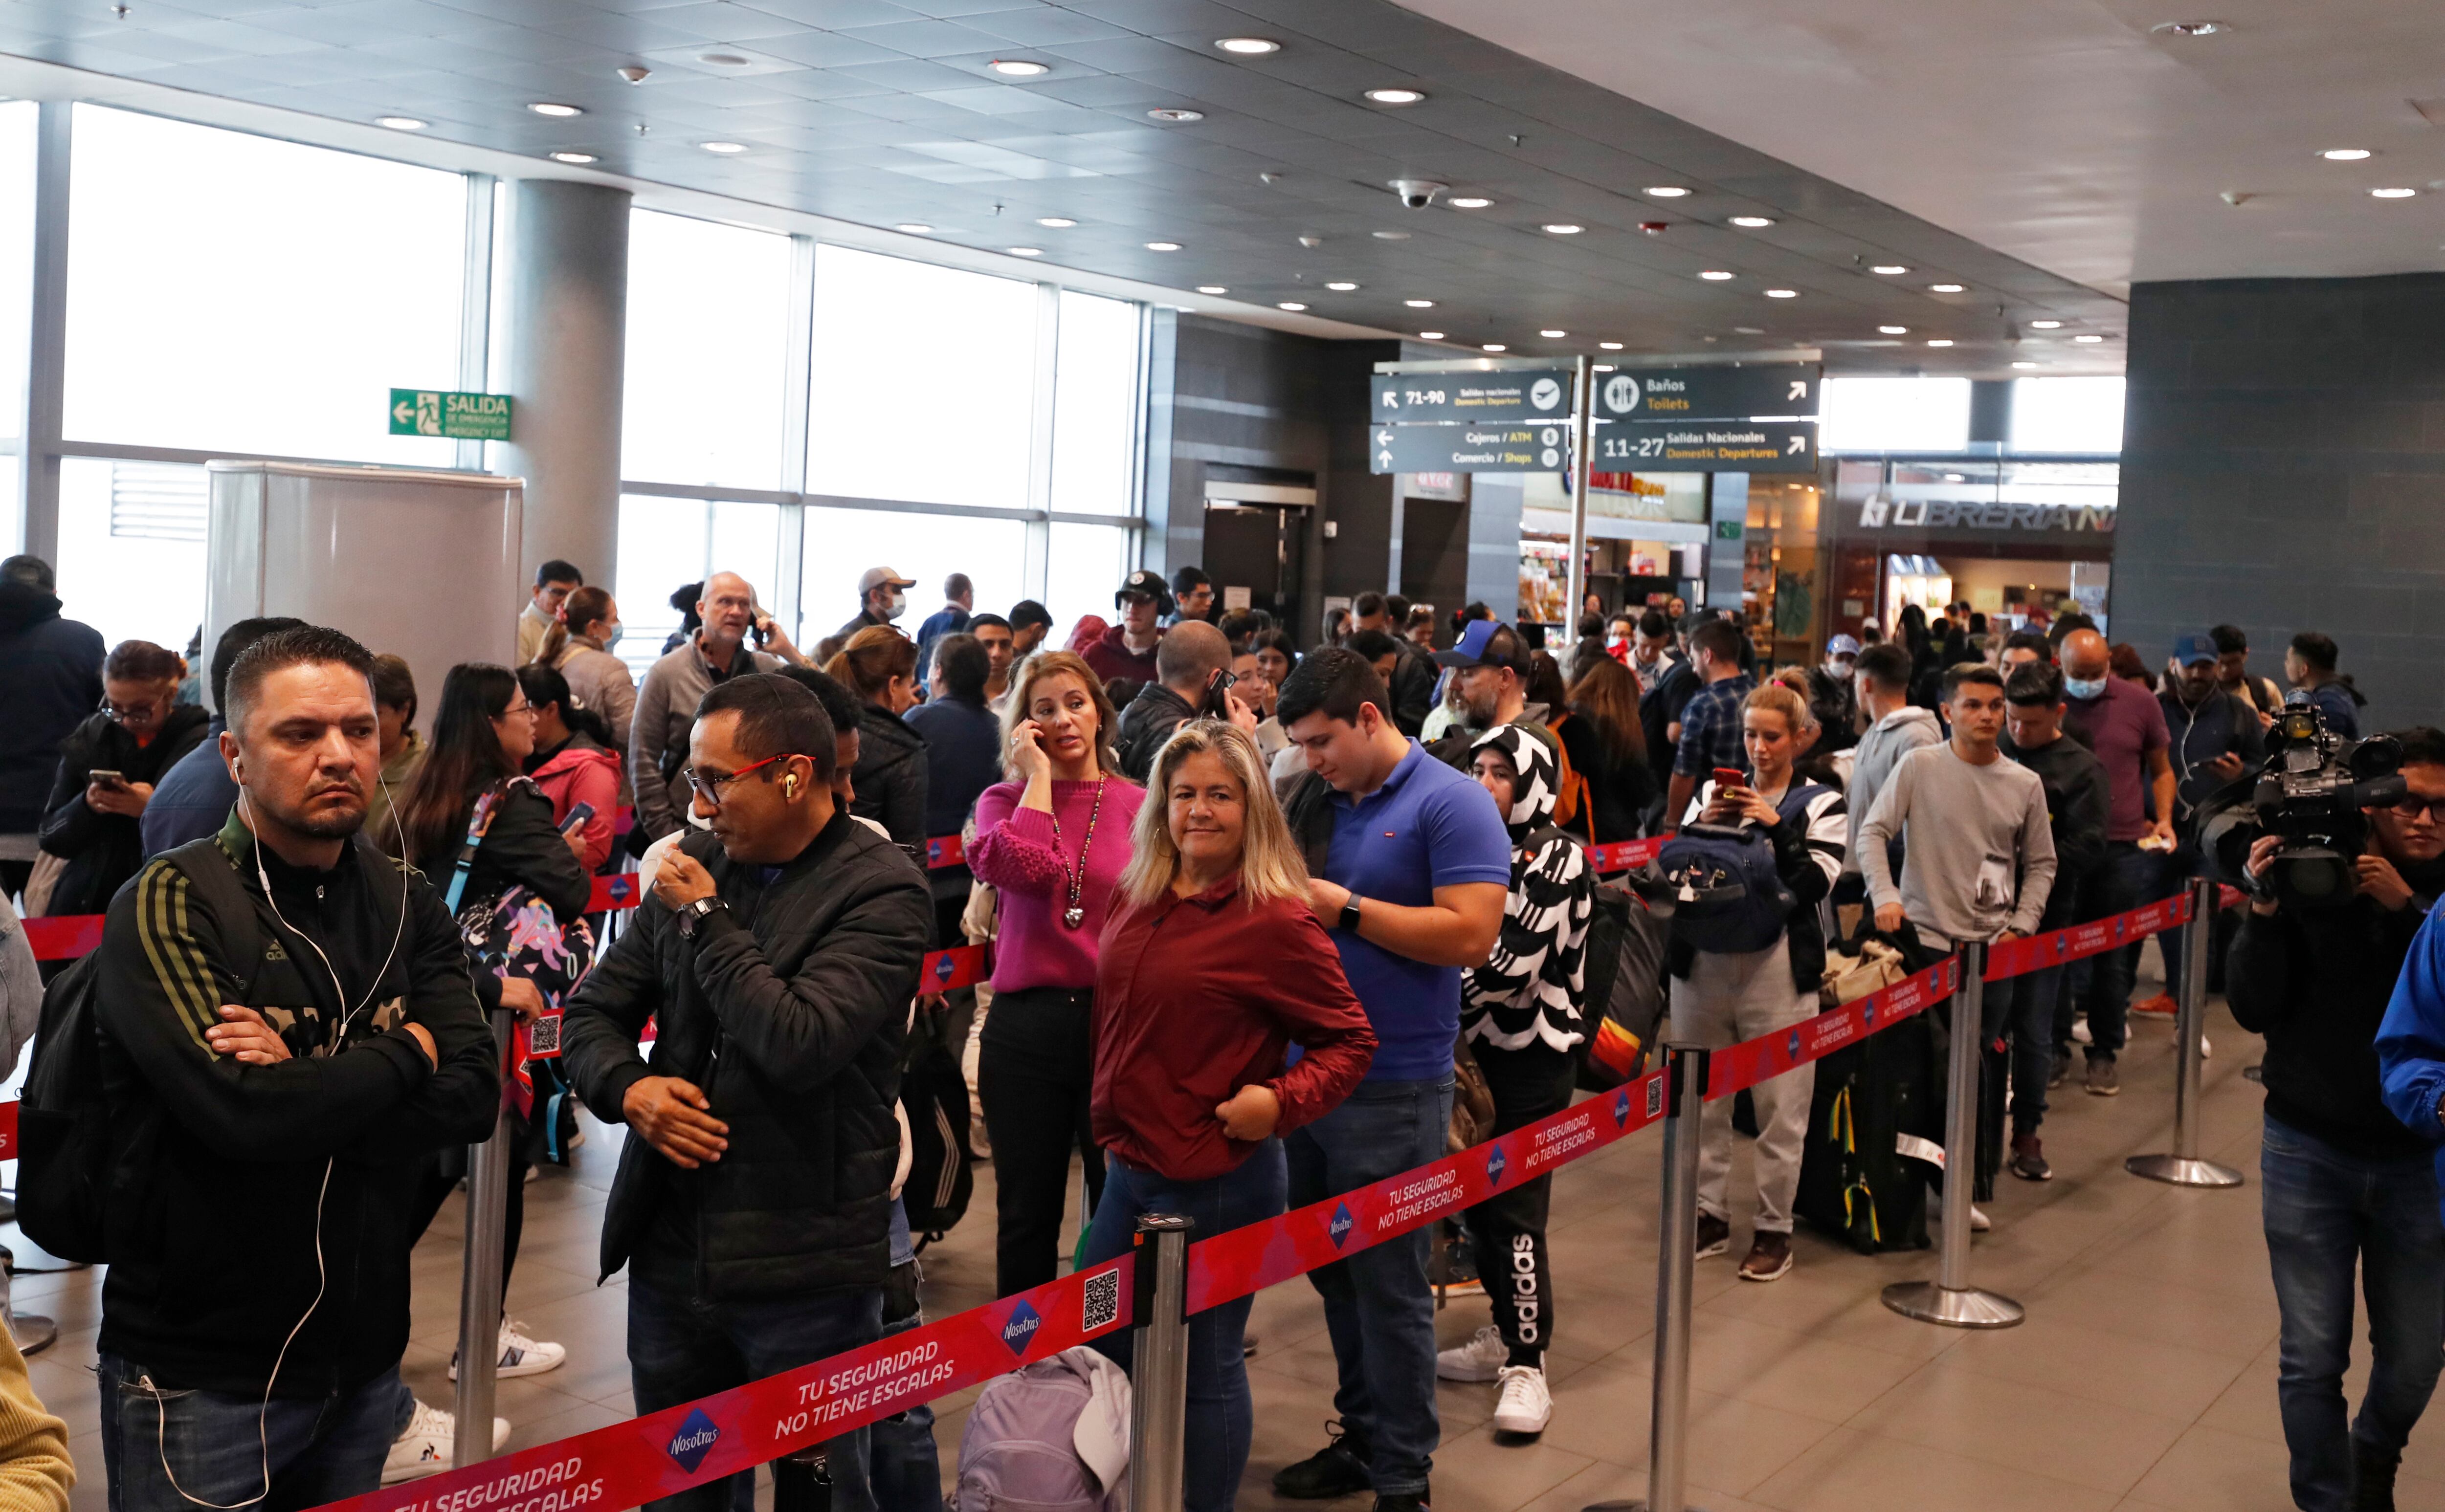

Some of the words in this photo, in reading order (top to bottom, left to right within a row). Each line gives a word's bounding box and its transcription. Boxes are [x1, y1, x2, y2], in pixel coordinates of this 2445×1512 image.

[1460, 388, 1485, 397] Salidas
[1646, 378, 1685, 392] Baños
[446, 394, 508, 415] SALIDA
[1405, 390, 1445, 405] 71-90
[1454, 397, 1486, 406] Domestic
[1647, 397, 1689, 410] Toilets
[1465, 432, 1500, 446] Cajeros
[1510, 432, 1532, 443] ATM
[1604, 438, 1665, 458] 11-27
[1666, 432, 1704, 444] Salidas
[1706, 431, 1766, 443] Nacionales
[1452, 452, 1495, 463] Comercio
[1504, 452, 1532, 465] Shops
[1666, 448, 1715, 459] Domestic
[1719, 447, 1779, 460] Departures
[1535, 1130, 1545, 1147] TU
[1546, 1113, 1589, 1142] SEGURIDAD
[1526, 1152, 1539, 1169] NO
[1540, 1141, 1562, 1162] TIENE
[1563, 1126, 1596, 1153] ESCALAS
[1389, 1188, 1402, 1206] TU
[1403, 1169, 1456, 1201] SEGURIDAD
[1378, 1212, 1394, 1231] NO
[1396, 1200, 1423, 1223] TIENE
[1423, 1184, 1464, 1213] ESCALAS
[1511, 1233, 1538, 1344] adidas
[1004, 1316, 1039, 1340] Nosotras
[799, 1379, 825, 1405] TU
[828, 1341, 938, 1395] SEGURIDAD
[775, 1412, 808, 1440] NO
[813, 1389, 869, 1426] TIENE
[871, 1359, 955, 1406] ESCALAS
[670, 1427, 718, 1455] Nosotras
[436, 1457, 582, 1512] SEGURIDAD
[496, 1478, 604, 1512] CALAS
